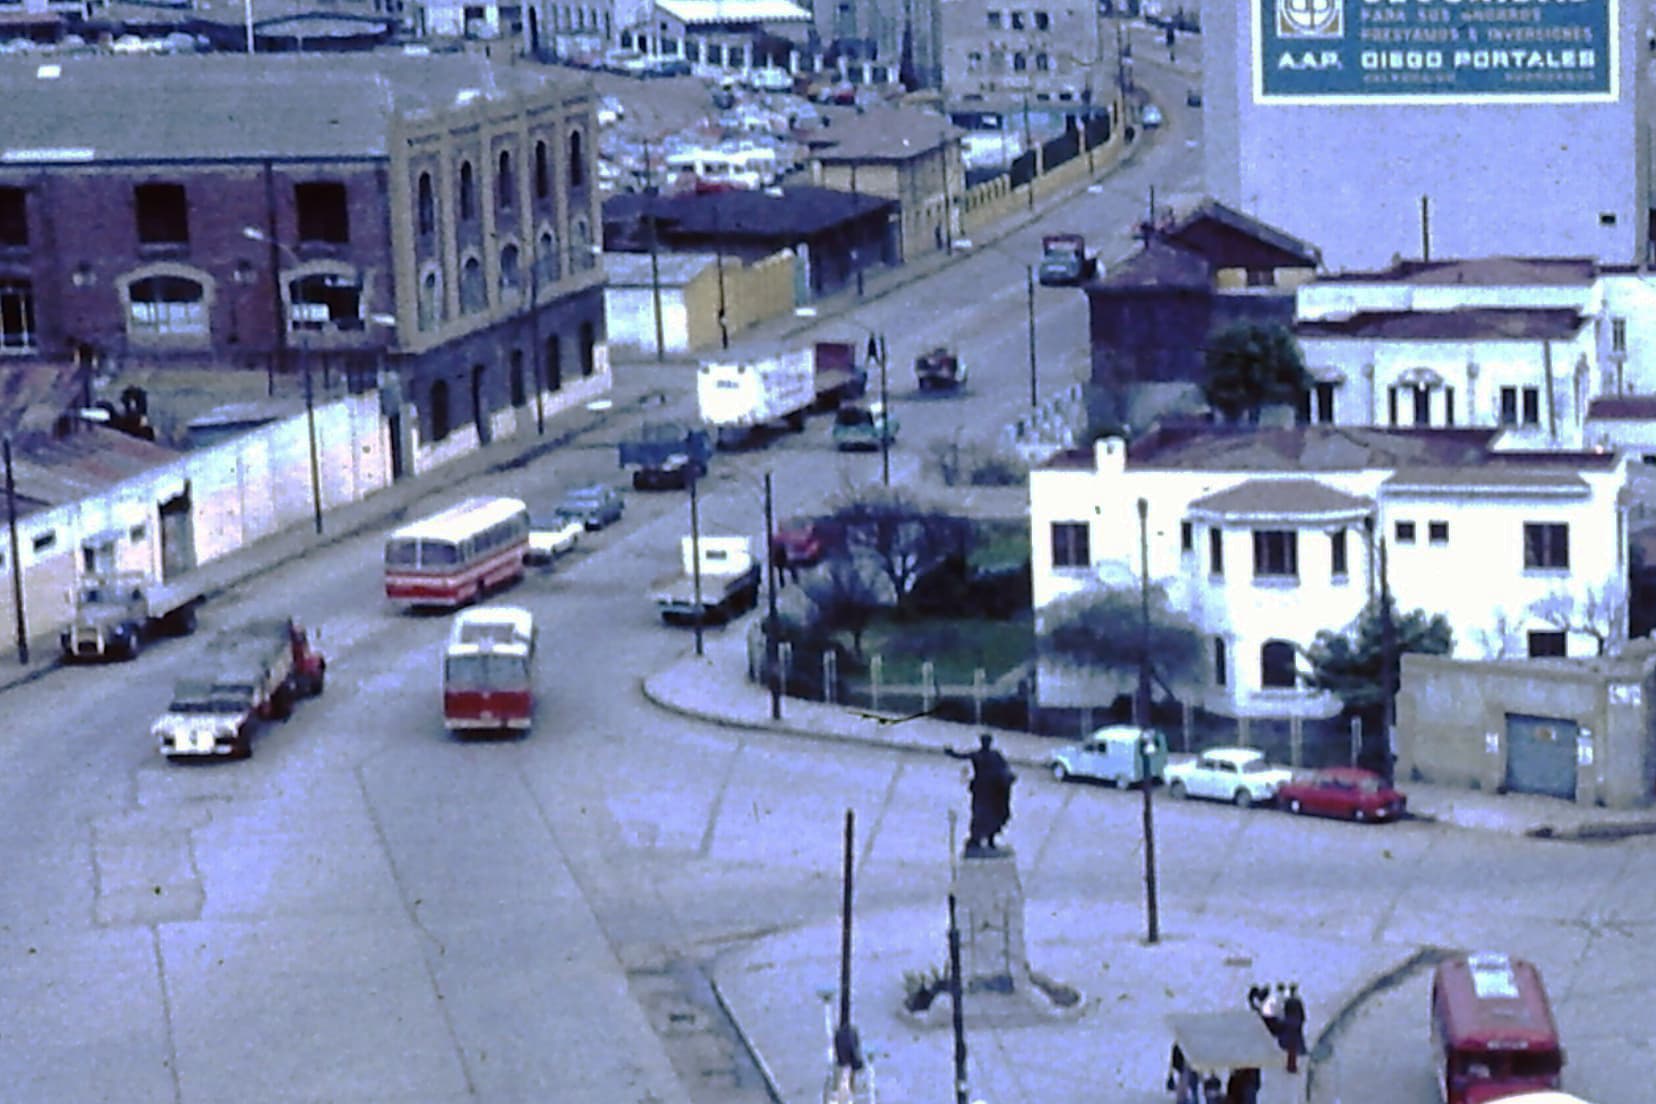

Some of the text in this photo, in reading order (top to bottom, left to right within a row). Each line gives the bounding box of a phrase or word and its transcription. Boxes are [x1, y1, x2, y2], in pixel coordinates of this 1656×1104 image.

[1360, 8, 1406, 22] PARA
[1361, 50, 1596, 69] DIEGO PORTALES
